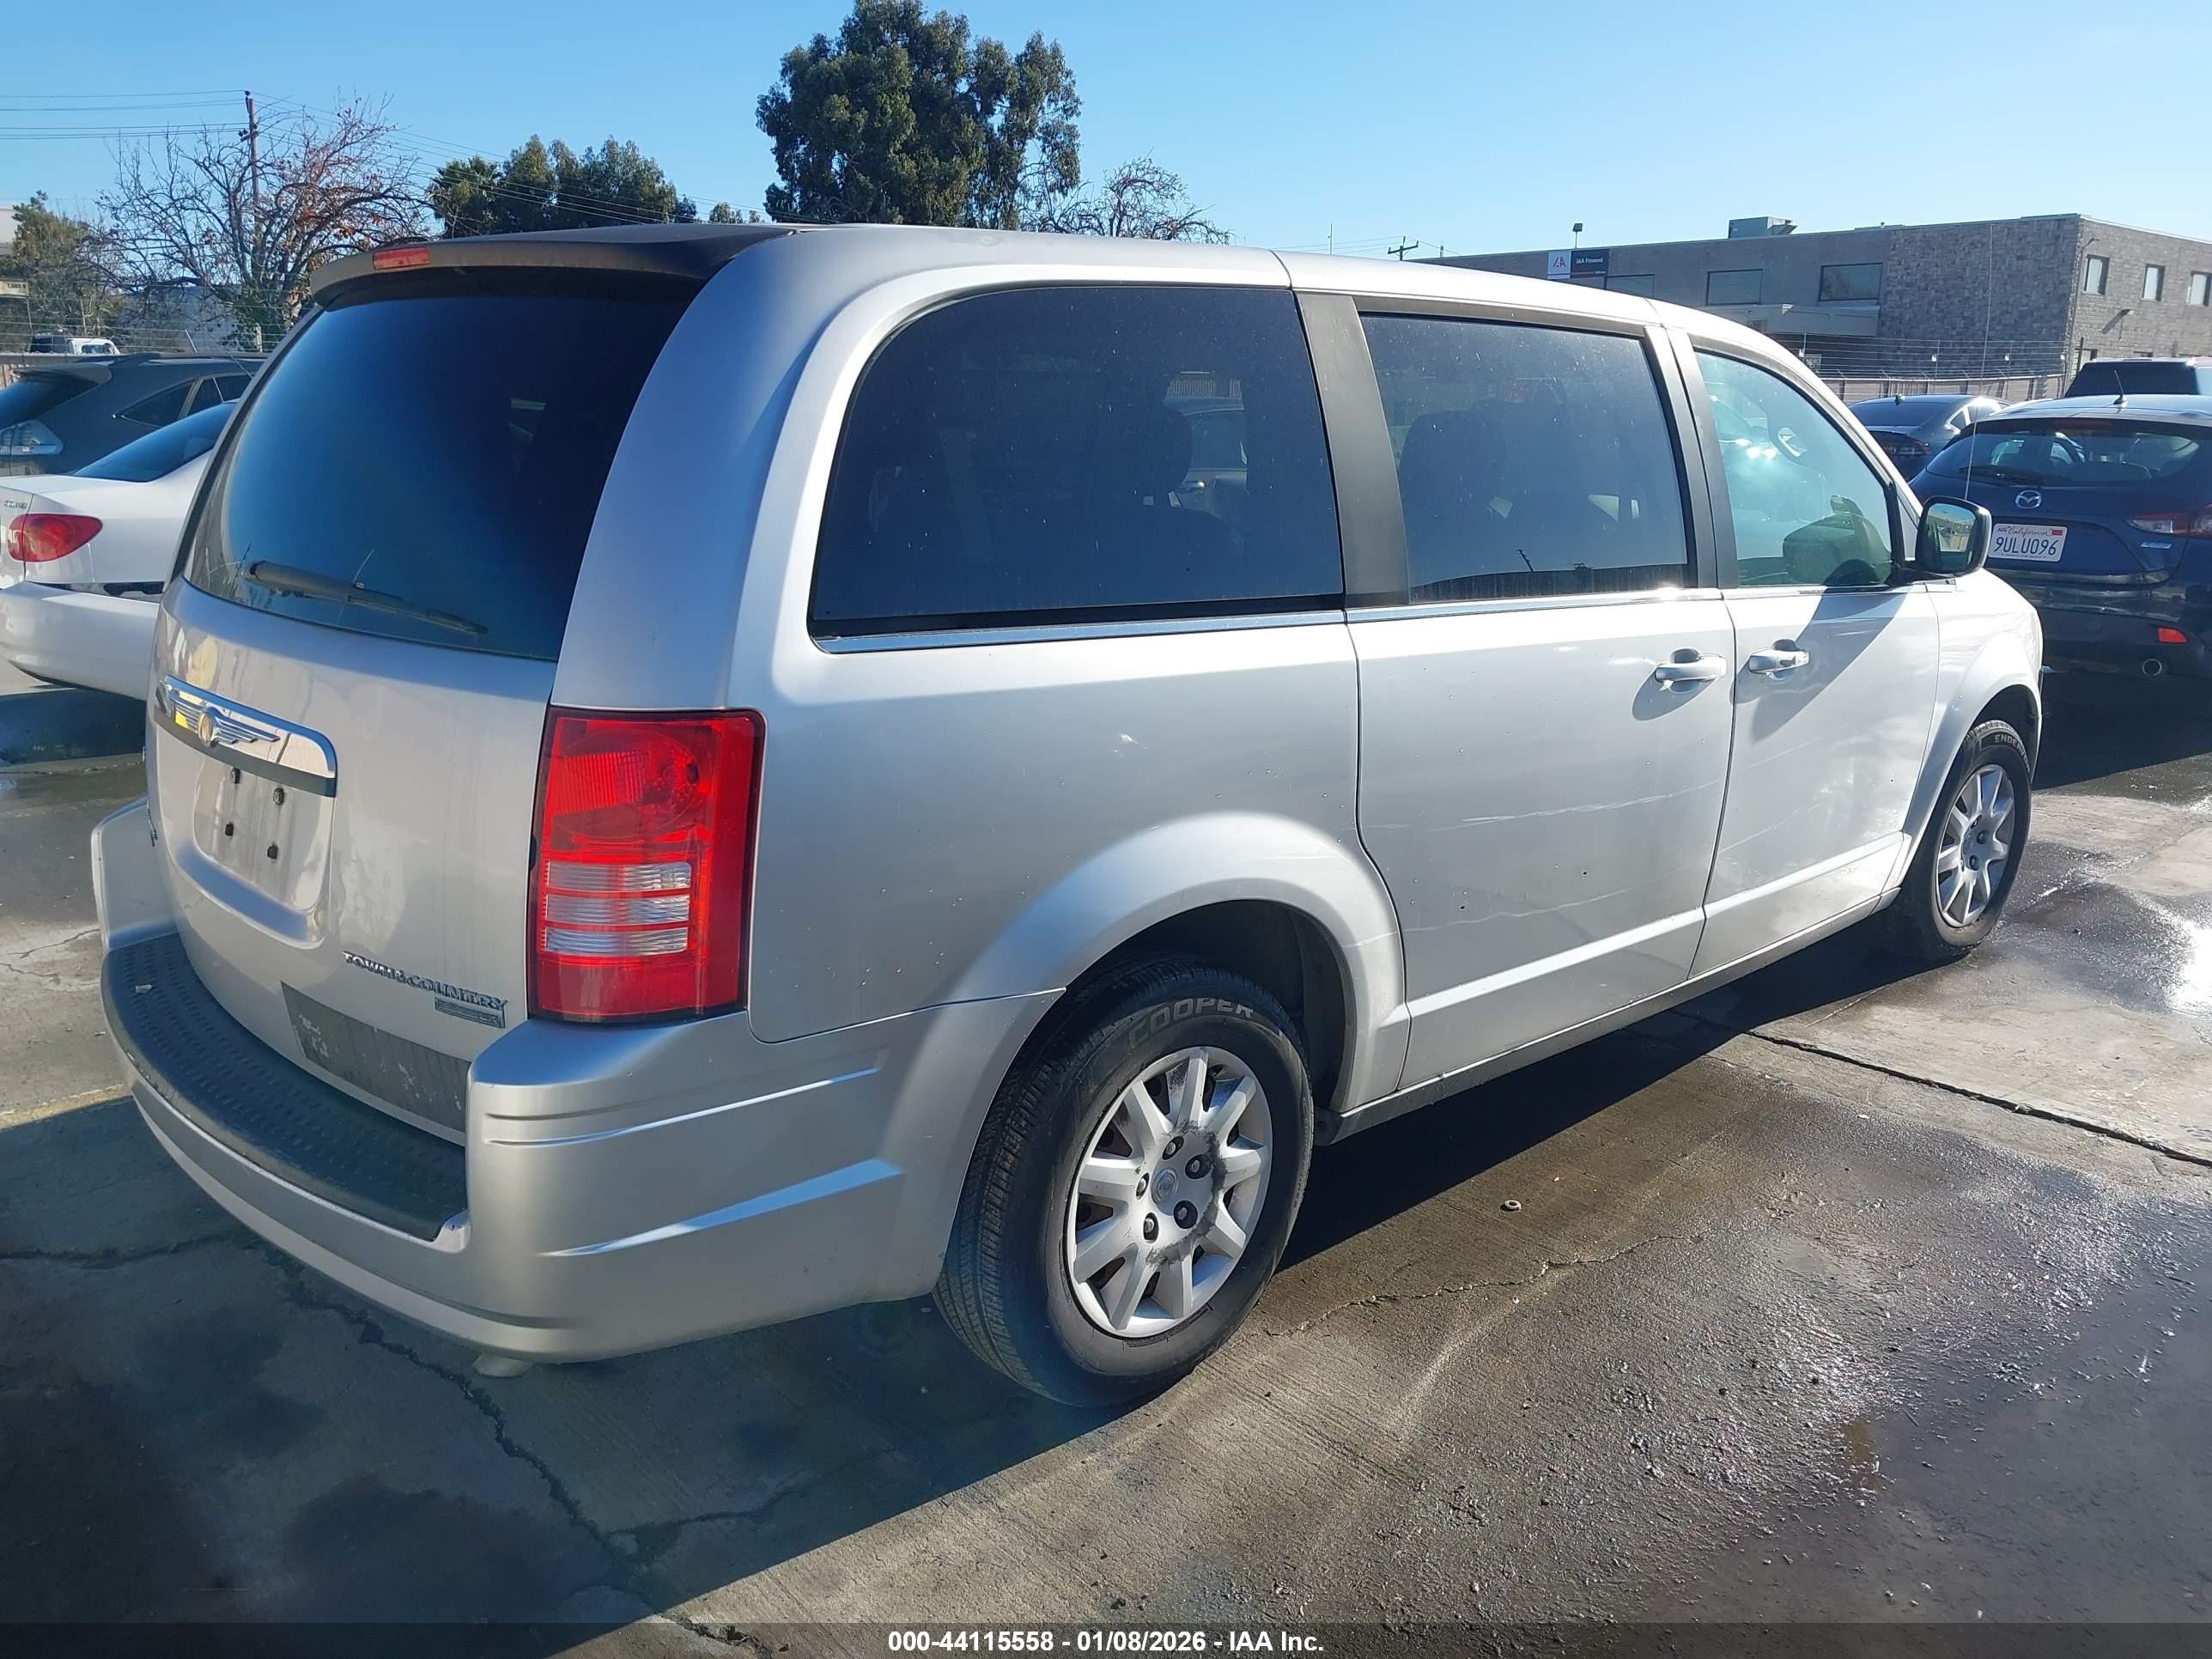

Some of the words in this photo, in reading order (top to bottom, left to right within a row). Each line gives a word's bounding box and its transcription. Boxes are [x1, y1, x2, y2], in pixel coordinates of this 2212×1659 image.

[2008, 526, 2048, 537] California
[1993, 537, 2059, 556] 9ULU096
[1128, 997, 1254, 1049] COOPER
